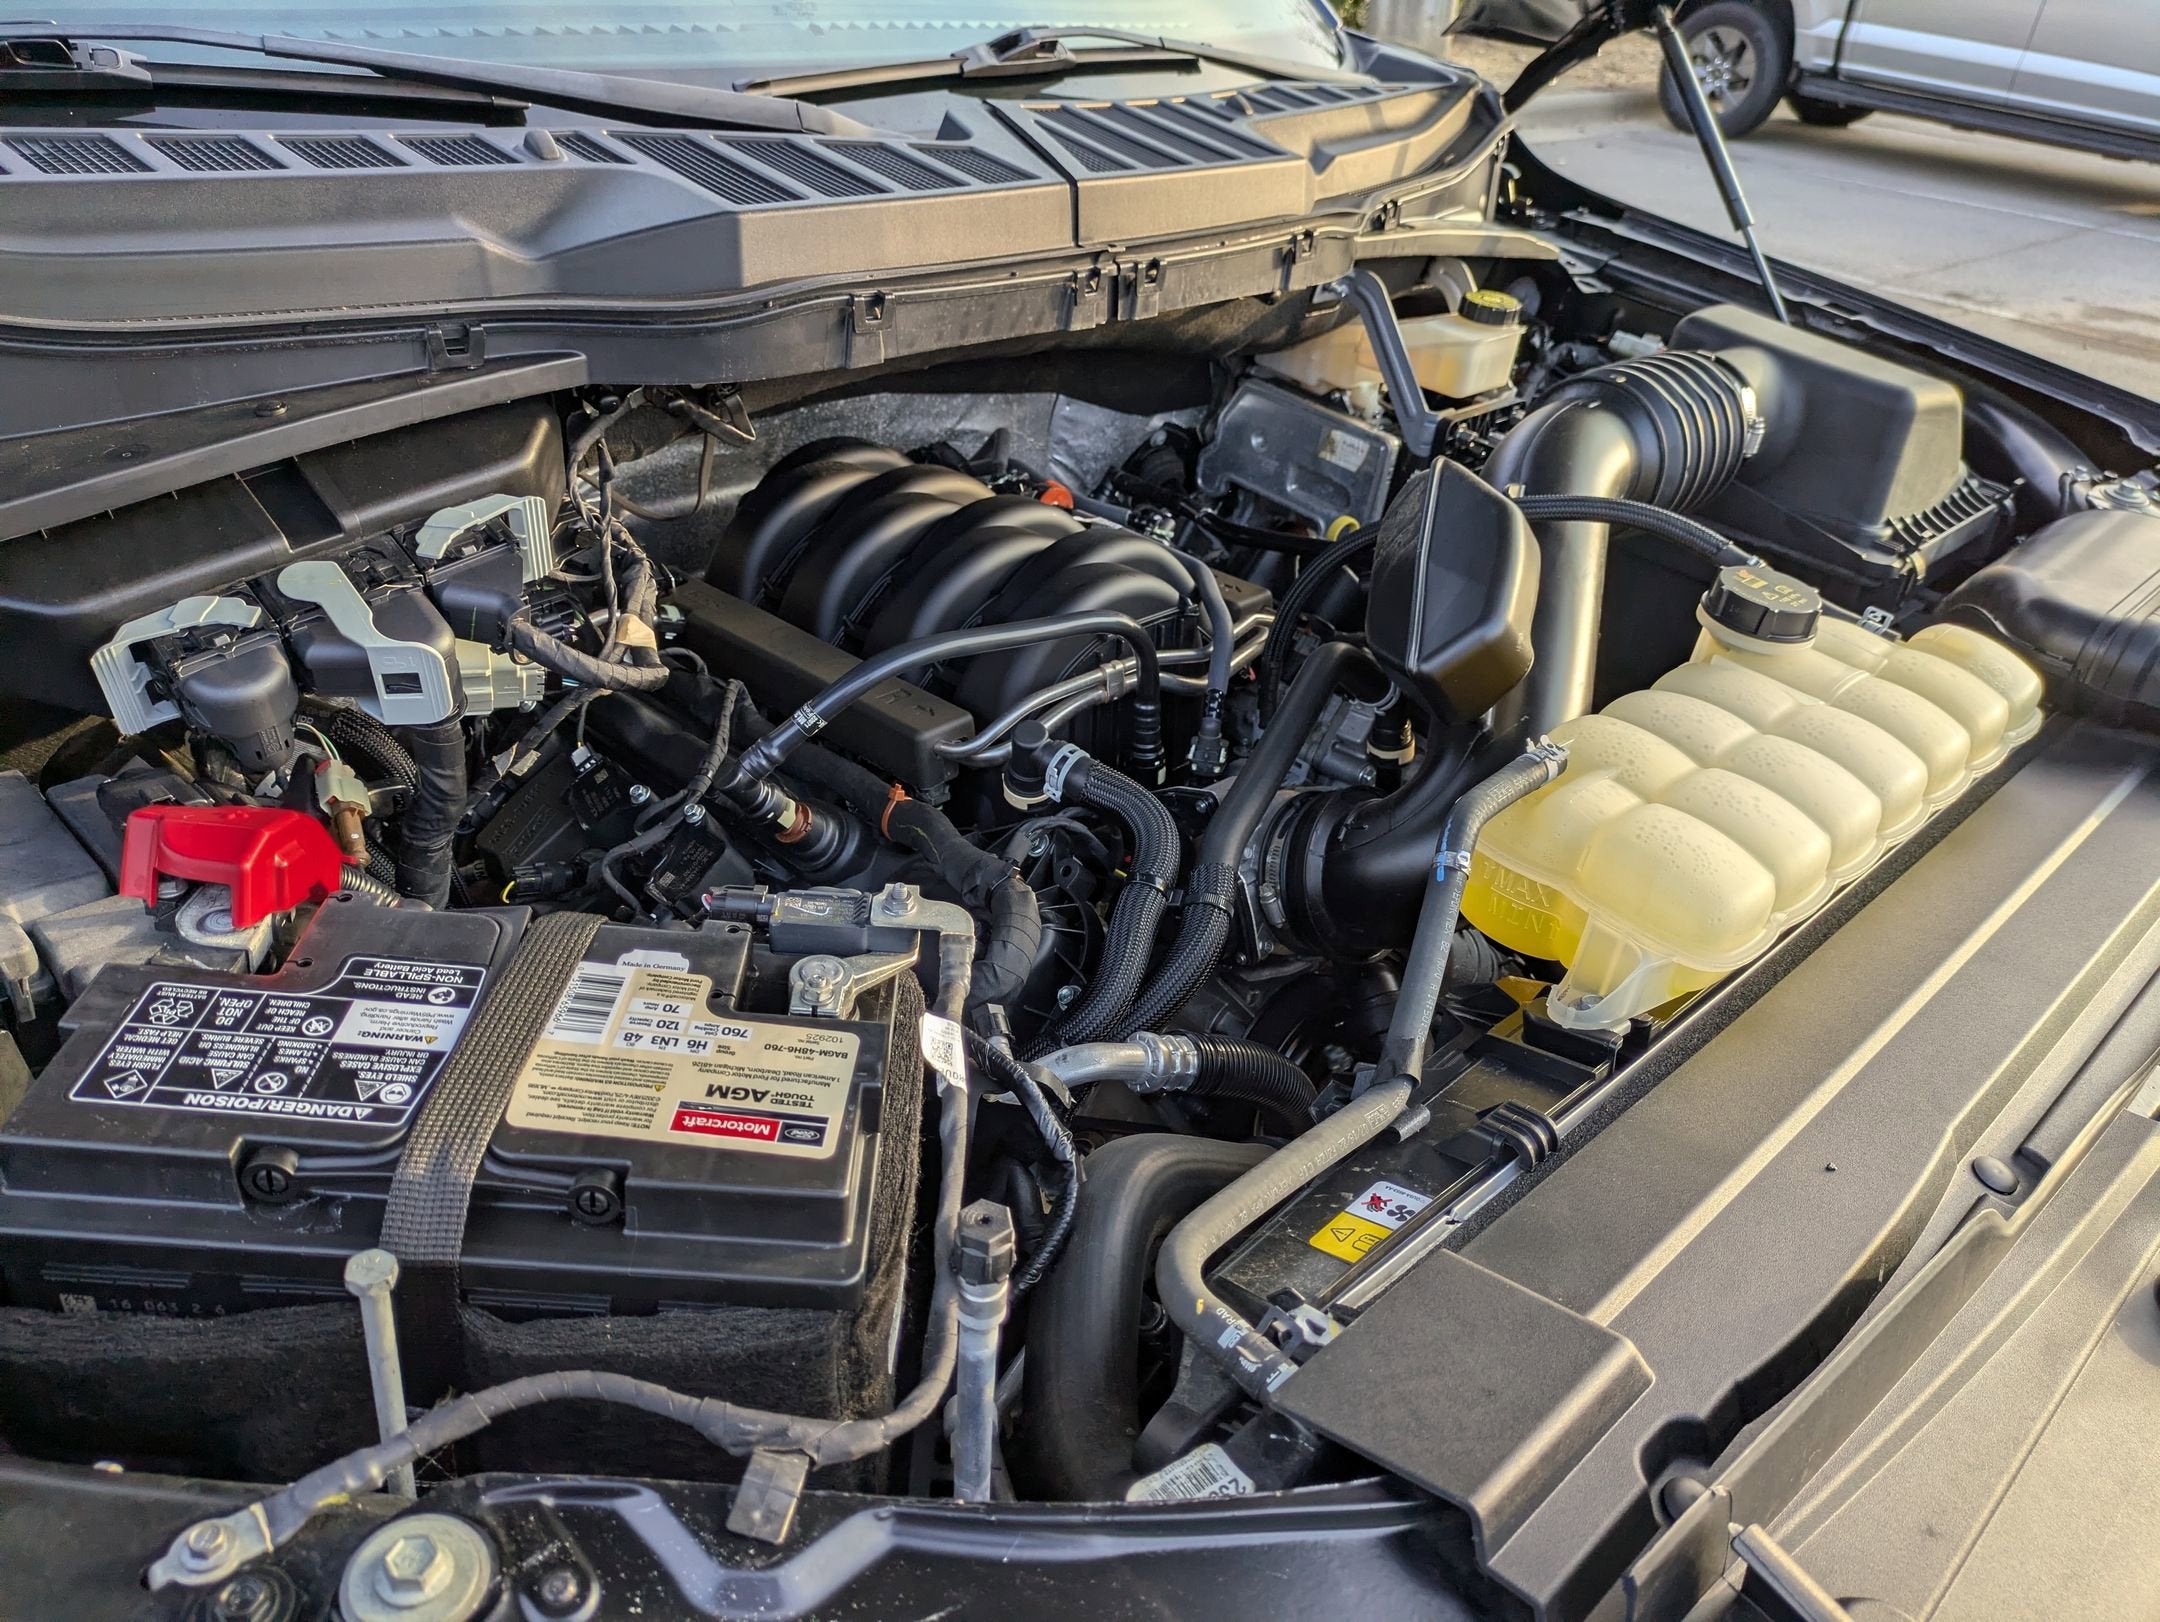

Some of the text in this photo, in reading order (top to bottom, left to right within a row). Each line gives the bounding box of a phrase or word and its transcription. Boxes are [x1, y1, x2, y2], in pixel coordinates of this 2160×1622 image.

[1494, 868, 1549, 906] MAX
[374, 963, 410, 972] Battery
[652, 963, 685, 972] Germany
[363, 969, 463, 983] NON-SPILLABLE
[218, 997, 253, 1007] OPEN.
[268, 1000, 310, 1009] CHILDREN.
[216, 1007, 243, 1016] NOT
[276, 1008, 306, 1016] REACH
[662, 1004, 680, 1013] 70
[215, 1017, 234, 1025] DO
[391, 1020, 439, 1030] Reproductive
[656, 1020, 680, 1030] 120
[274, 1024, 296, 1032] KEEP
[721, 1027, 748, 1038] 760
[124, 1034, 160, 1043] MEDICAL
[160, 1030, 183, 1038] HELP
[357, 1031, 424, 1042] WARNING:
[623, 1033, 643, 1042] 48
[806, 1033, 843, 1043] 102925
[200, 1034, 265, 1045] SEVERE BURNS.
[651, 1036, 679, 1046] LN3
[213, 1043, 260, 1052] BLINDNESS
[277, 1040, 317, 1049] SMOKING
[687, 1040, 708, 1050] H6
[208, 1050, 235, 1058] CAUSE
[279, 1048, 312, 1057] FLAMES
[384, 1049, 416, 1057] INJURY.
[715, 1048, 736, 1056] Group
[764, 1044, 848, 1059] BAGM-48H6-760
[108, 1052, 166, 1063] IMMEDIATELY
[273, 1056, 308, 1064] SPARKS
[332, 1052, 379, 1061] BLINDNESS
[380, 1056, 407, 1064] CAUSE
[178, 1057, 250, 1068] SULFURIC ACID
[340, 1061, 422, 1073] EXPLOSIVE GASES
[697, 1067, 730, 1077] Company
[713, 1063, 745, 1072] Michigan
[385, 1074, 418, 1082] SHIELD
[730, 1072, 751, 1080] Motor
[803, 1074, 836, 1082] American
[781, 1078, 830, 1088] Manufactured
[705, 1084, 770, 1103] AGM
[184, 1094, 355, 1117] DANGER/POISON
[770, 1099, 813, 1108] TESTED
[683, 1116, 771, 1135] Motorcraft
